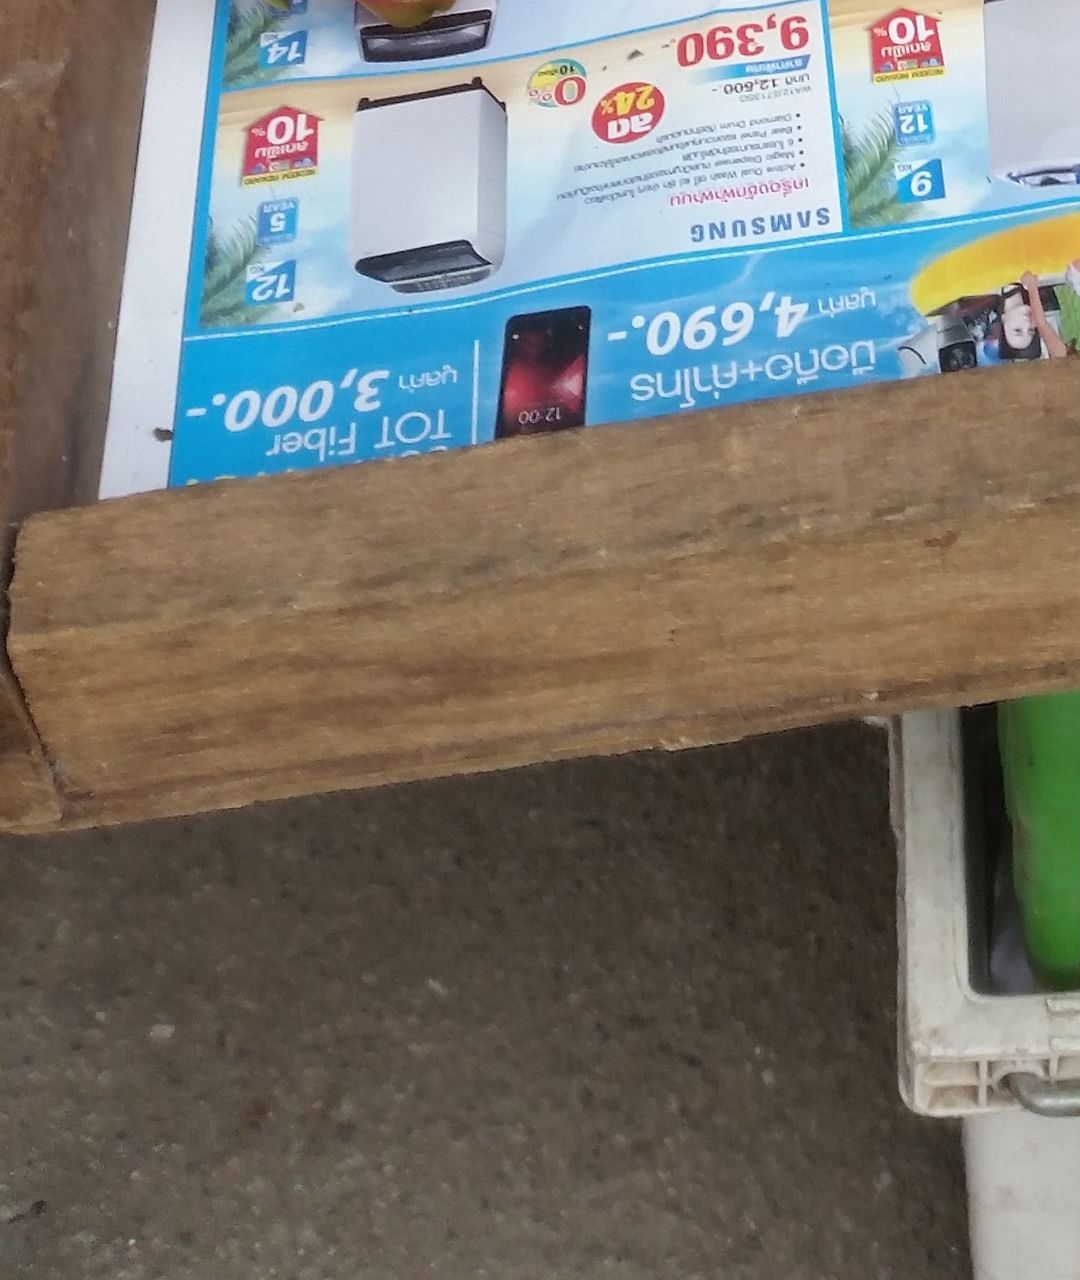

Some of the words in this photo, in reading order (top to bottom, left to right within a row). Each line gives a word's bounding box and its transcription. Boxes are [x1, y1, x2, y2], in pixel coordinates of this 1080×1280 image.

[661, 13, 810, 68] 9,390.-
[873, 14, 935, 45] 10%
[266, 40, 303, 64] 14
[599, 83, 656, 118] 24%
[250, 113, 315, 145] 10%
[607, 112, 654, 139] ลด
[899, 112, 929, 134] 12
[910, 170, 933, 197] 9
[270, 212, 286, 233] 5
[689, 207, 831, 243] SAMSUNG
[252, 271, 292, 302] 12
[817, 289, 877, 314] มูลค่า
[607, 290, 810, 356] 4,690.-
[398, 364, 458, 394] มูลค่า
[185, 368, 391, 433] 3,000.-
[265, 422, 357, 463] Fiber
[373, 408, 452, 449] TOT
